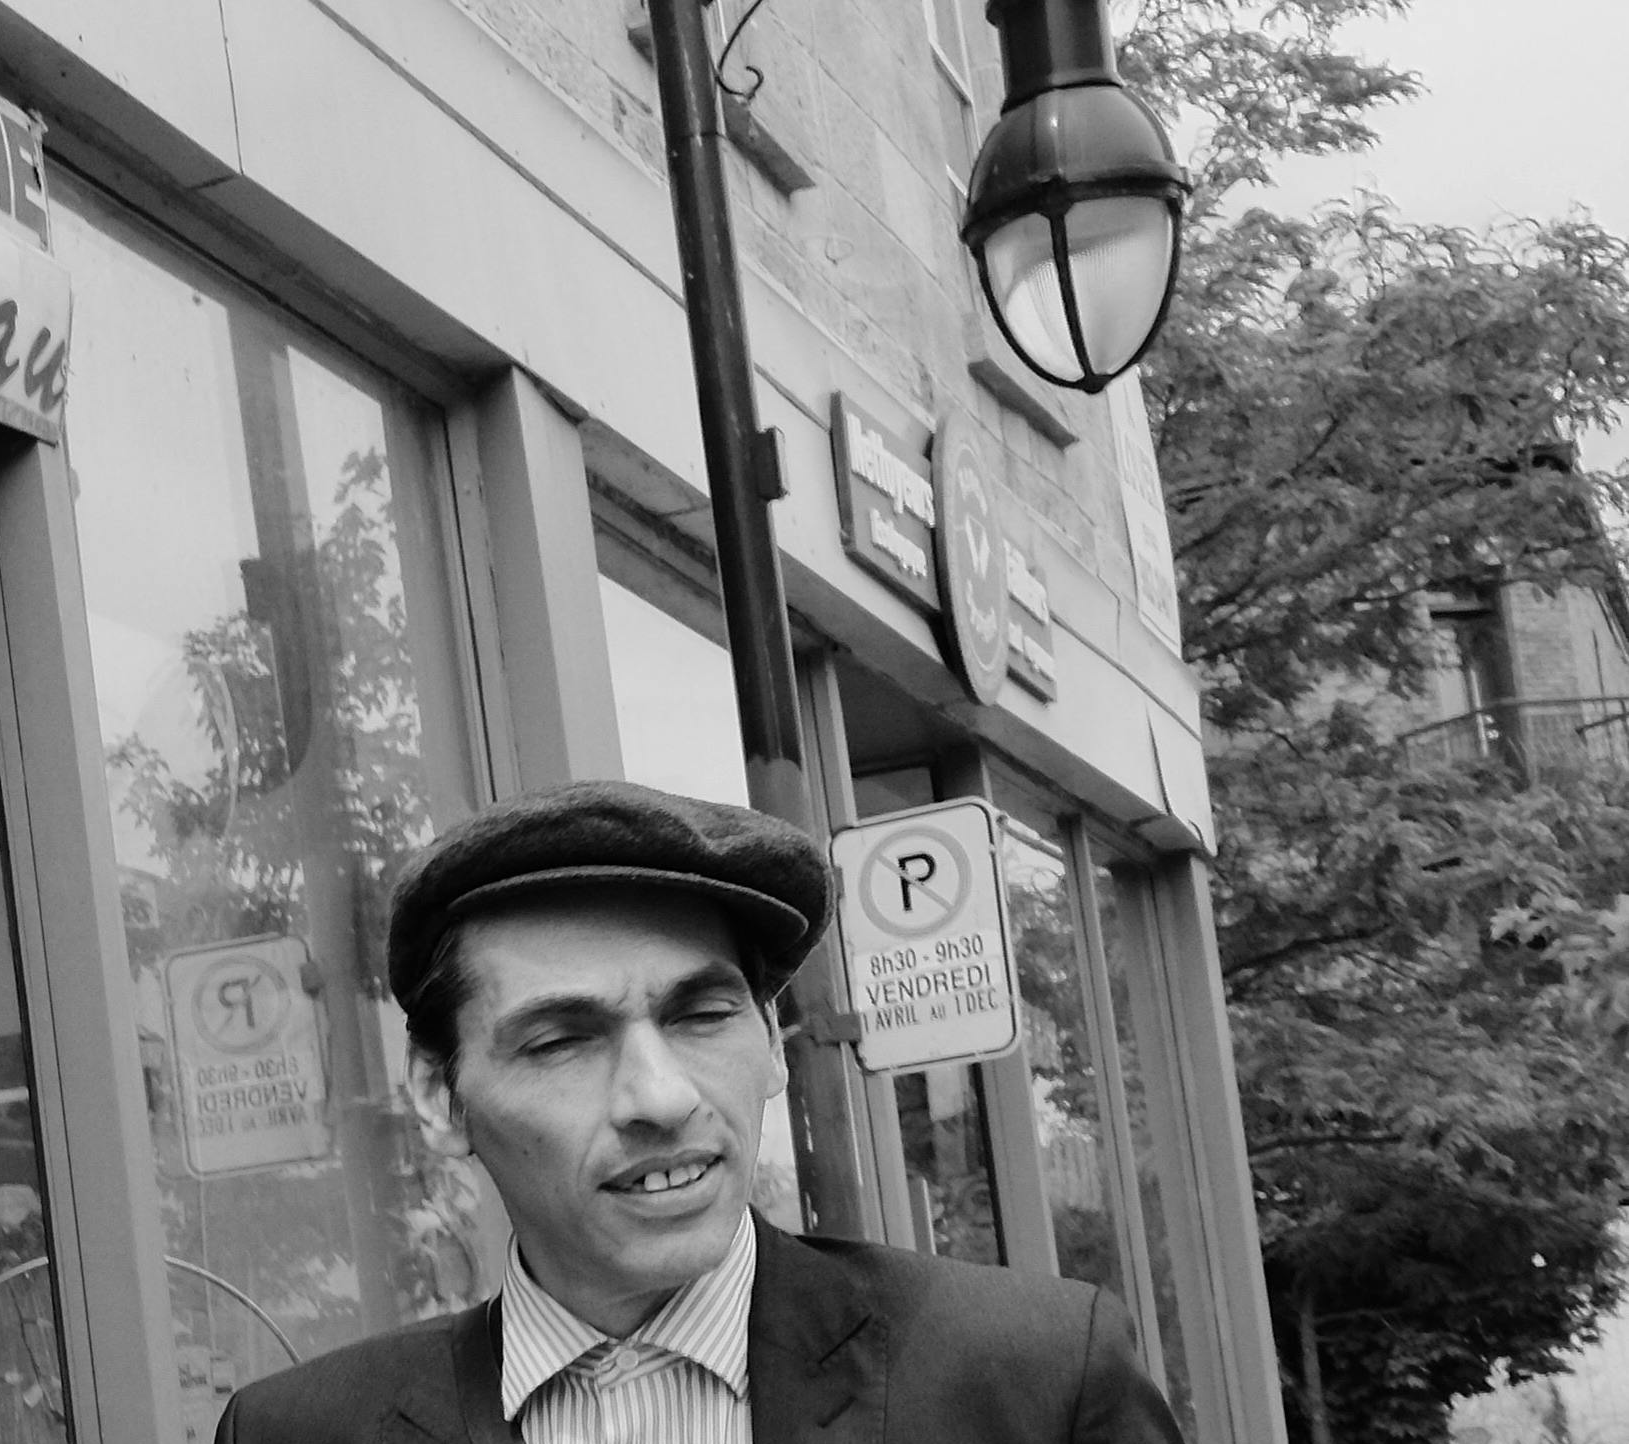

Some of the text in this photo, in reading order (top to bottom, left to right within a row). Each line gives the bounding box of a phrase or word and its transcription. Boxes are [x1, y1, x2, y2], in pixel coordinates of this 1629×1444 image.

[870, 948, 917, 977] 8h30
[935, 934, 983, 963] 9h30
[866, 963, 990, 1006] VENDREDI
[875, 1004, 919, 1031] AVRIL
